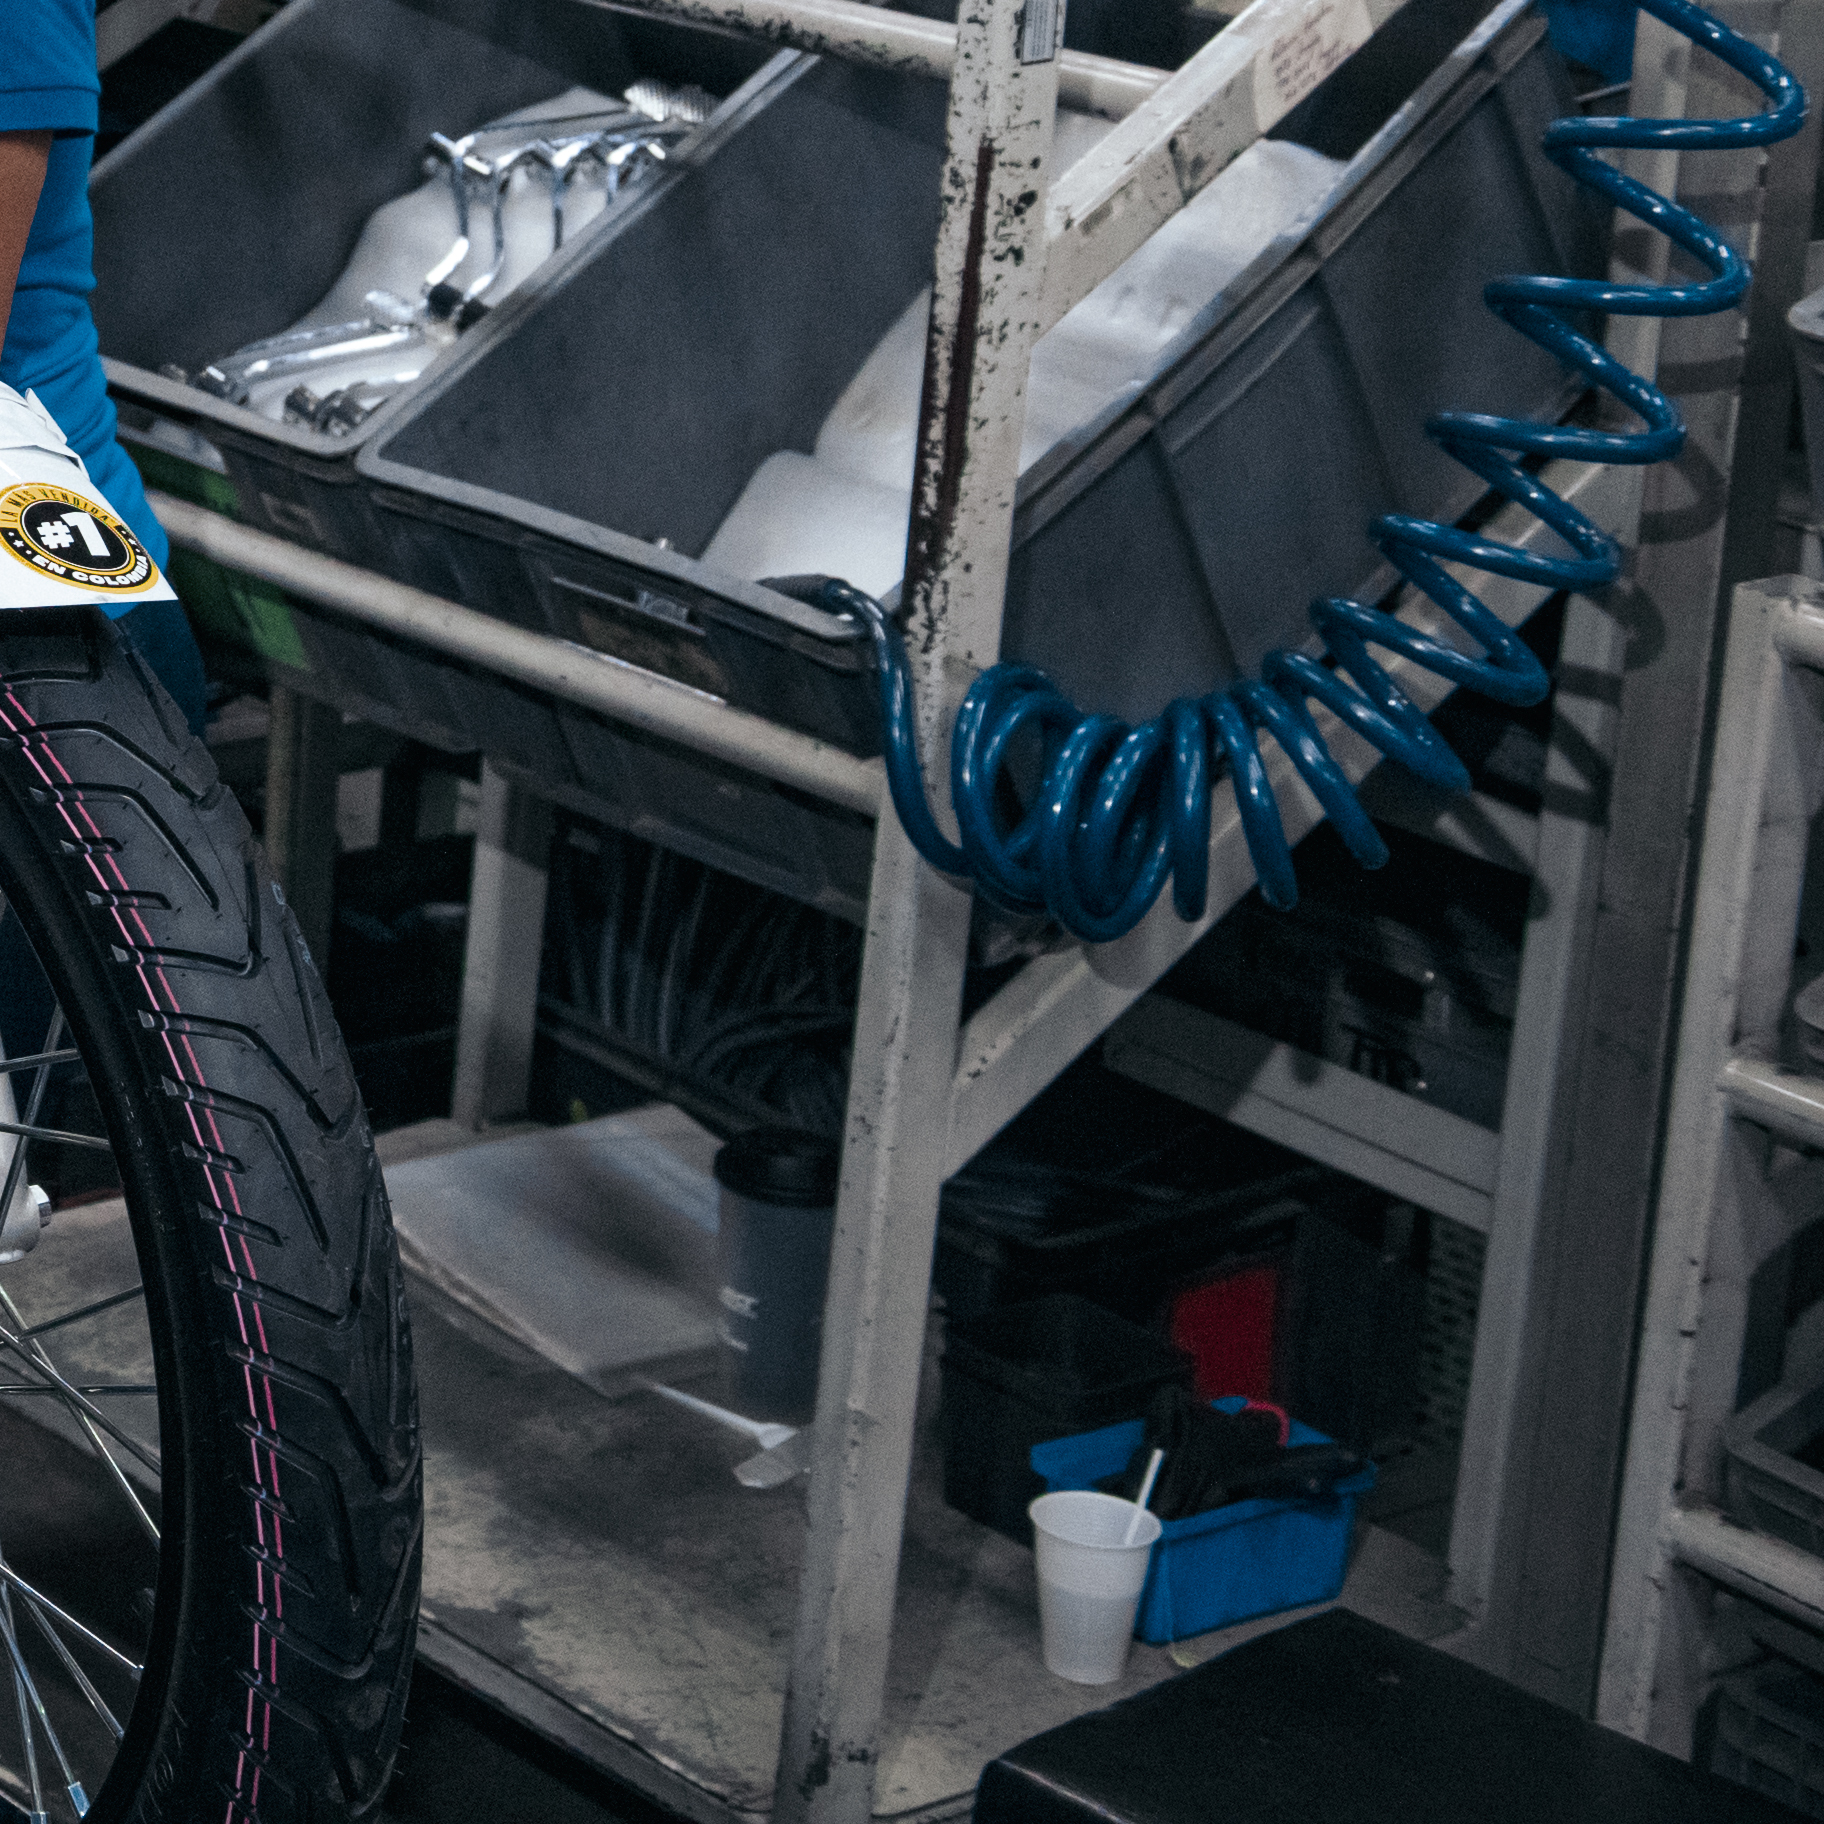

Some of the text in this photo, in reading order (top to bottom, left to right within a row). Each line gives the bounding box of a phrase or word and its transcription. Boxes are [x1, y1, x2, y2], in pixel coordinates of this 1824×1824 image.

[0, 510, 19, 523] LA
[38, 488, 109, 522] VENDIDA
[36, 511, 110, 557] #1
[32, 554, 150, 586] EN COLOMBIA
